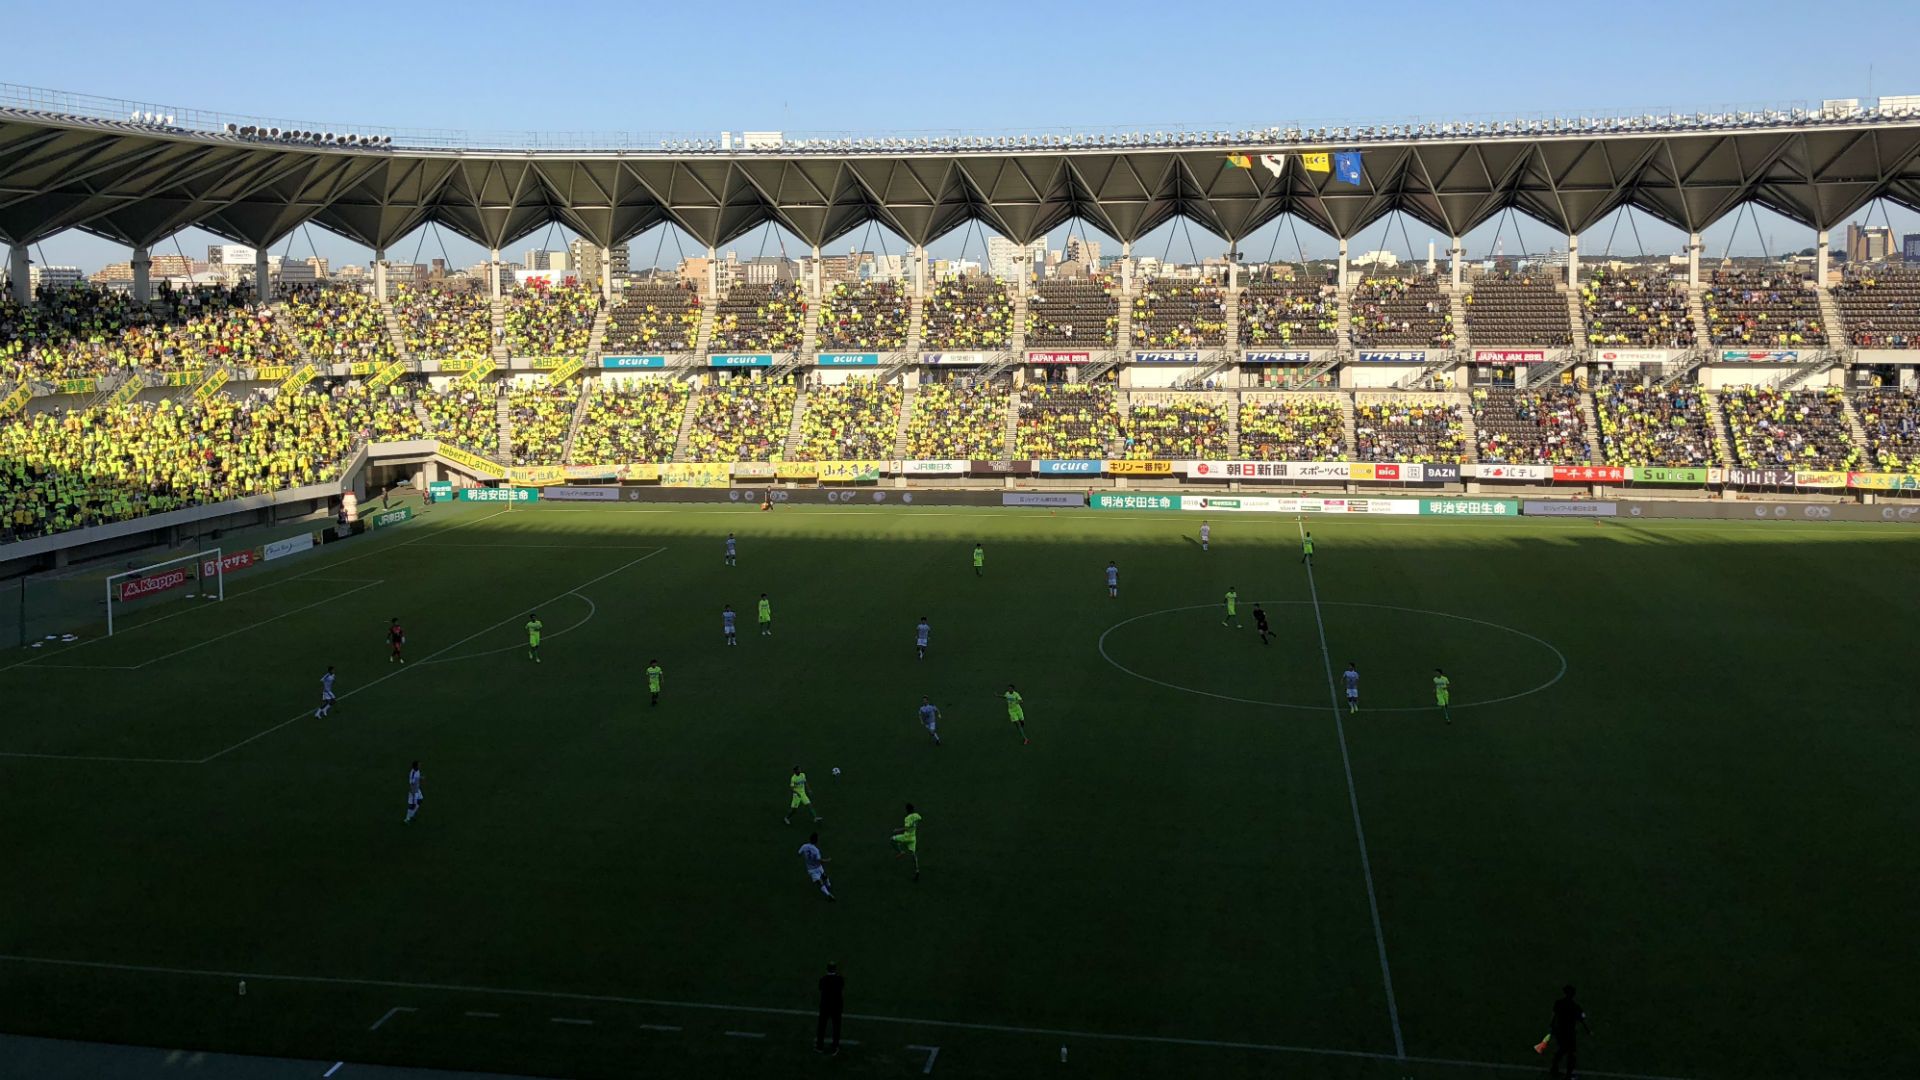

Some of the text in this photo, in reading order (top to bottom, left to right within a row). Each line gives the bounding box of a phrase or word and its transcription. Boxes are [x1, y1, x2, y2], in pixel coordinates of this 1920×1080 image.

[618, 357, 649, 365] acure
[1136, 353, 1198, 361] フクダ電子
[913, 463, 953, 471] JR東日本
[1052, 462, 1089, 471] acure
[1226, 463, 1287, 476] 朝日新聞
[1299, 465, 1349, 476] スポーツくじ
[1428, 468, 1456, 477] DAZN
[1567, 468, 1623, 480] 千葉日報
[1643, 469, 1695, 480] Suica
[467, 489, 529, 501] 明治安田生命
[1101, 496, 1171, 508] 明治安田生命
[1430, 502, 1506, 514] 明治安田生命
[378, 510, 406, 526] JR東日本
[140, 572, 184, 592] Kappa
